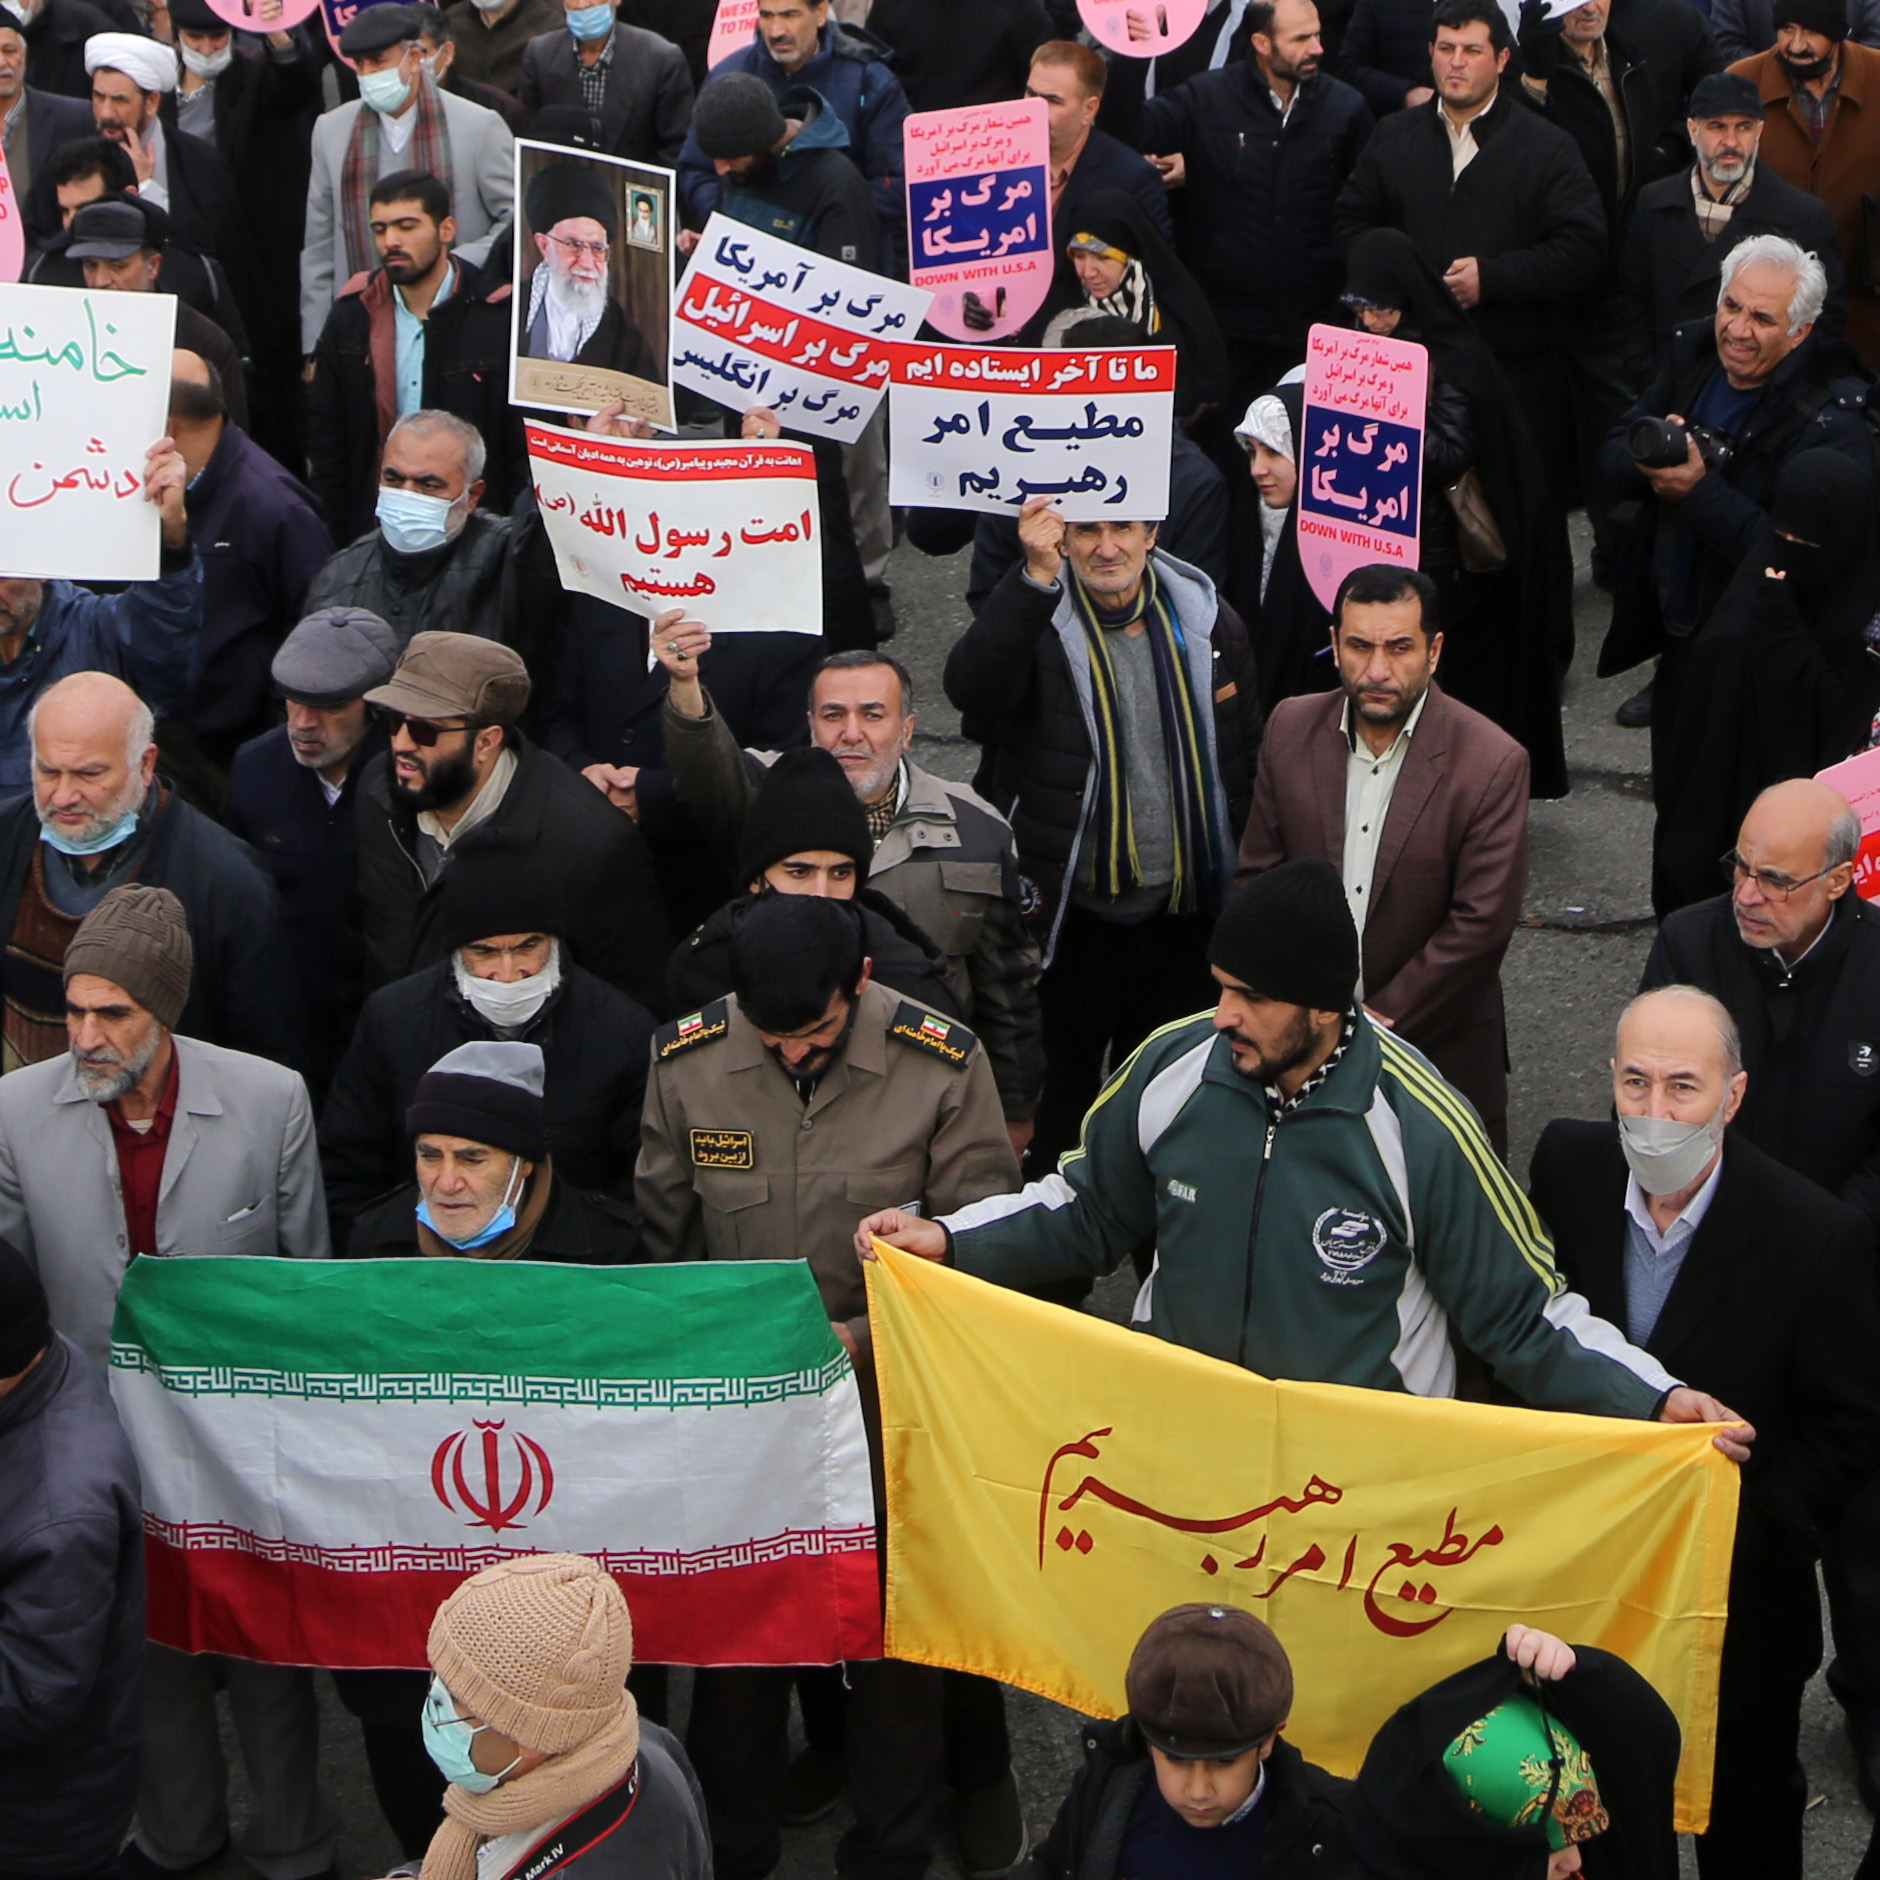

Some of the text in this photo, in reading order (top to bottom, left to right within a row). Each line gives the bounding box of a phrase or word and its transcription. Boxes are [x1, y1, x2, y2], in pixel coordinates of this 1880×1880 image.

[923, 173, 1032, 222] مرگ بر
[922, 212, 1037, 257] امریکا
[714, 235, 906, 333] مرگ بر آمریکا
[915, 259, 1037, 287] DOWN WITH U.S.A
[683, 285, 891, 381] مرگ بر اسرائیل
[906, 352, 1159, 390] ما تا آخر ایستاده ایم
[769, 387, 799, 411] بر
[802, 390, 861, 424] مرگ
[922, 399, 1144, 452] مطیع امر
[1314, 422, 1409, 472] مرگ بر
[8, 437, 141, 508] دشمن
[959, 465, 1128, 505] رهبریم
[1311, 464, 1409, 527] امریکا
[535, 483, 812, 558] امت رسول الله (ص)
[1300, 519, 1404, 558] DOWN WITH U.S.A
[620, 567, 716, 601] هستیم
[1038, 1426, 1505, 1638] مطیع امر رهبریم
